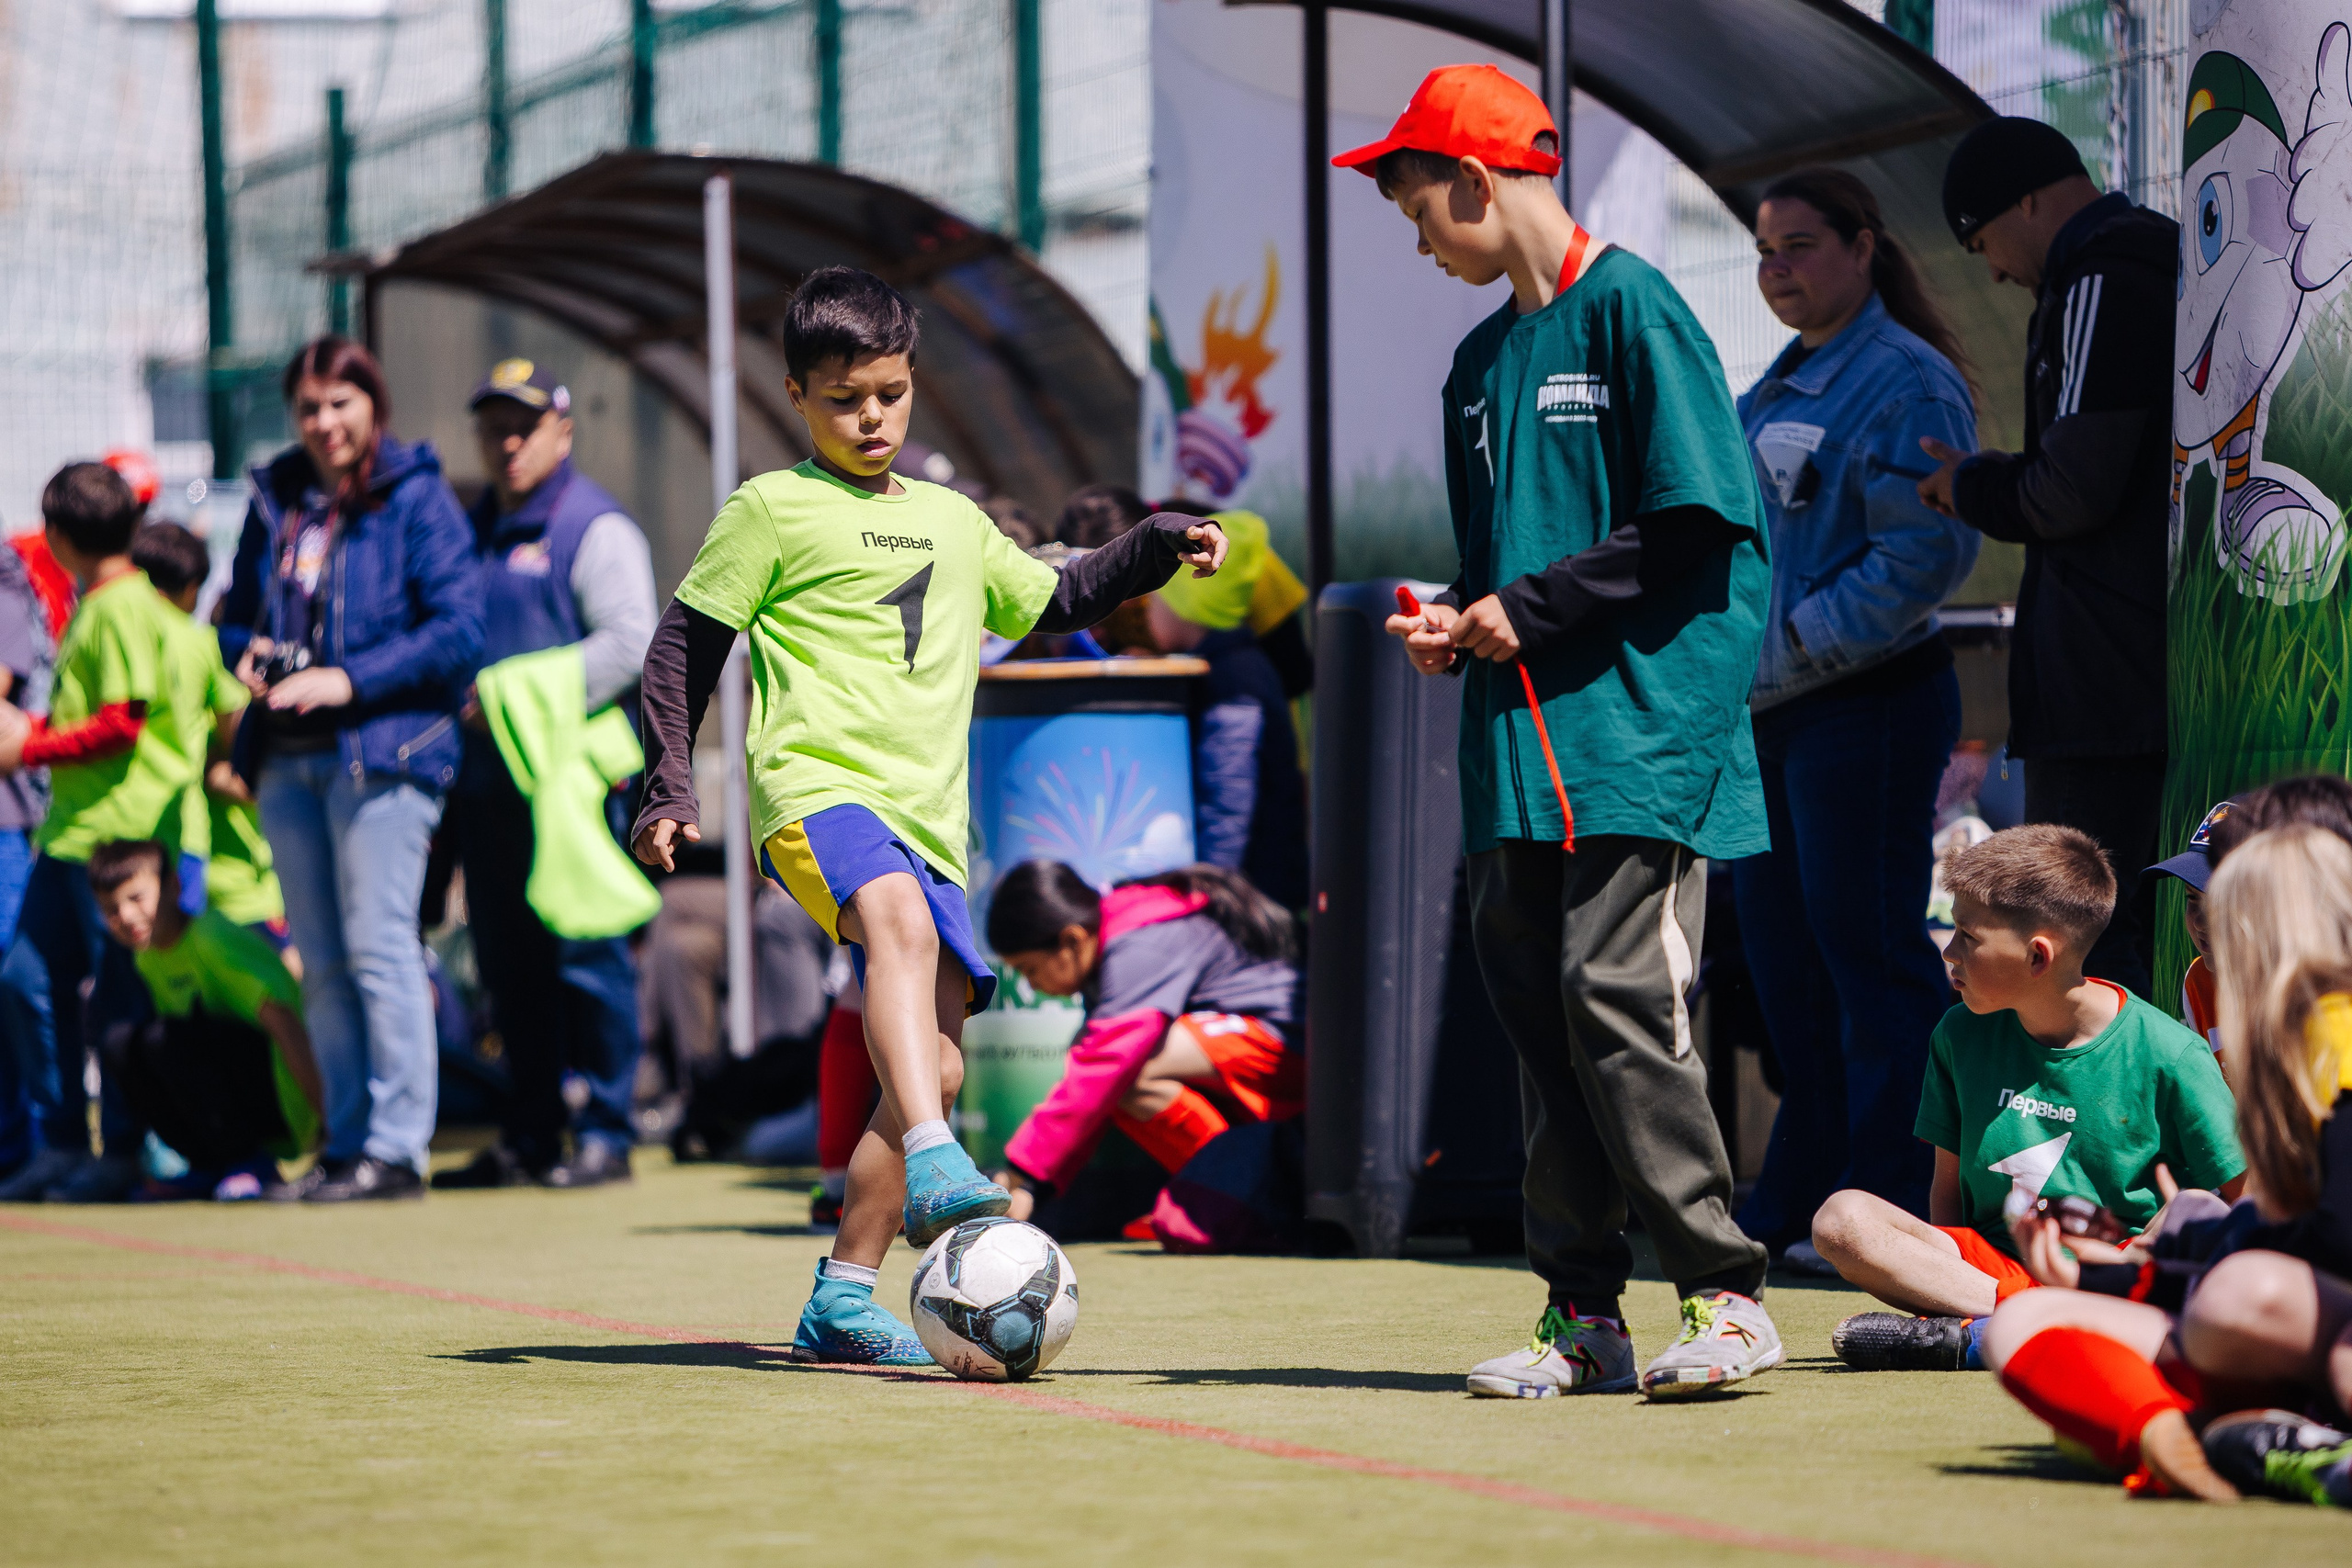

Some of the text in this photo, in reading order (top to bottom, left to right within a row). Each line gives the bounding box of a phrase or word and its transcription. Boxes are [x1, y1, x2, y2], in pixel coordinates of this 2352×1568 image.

[1537, 383, 1610, 412] КОМАНДА
[861, 532, 933, 553] Первые
[1997, 1088, 2076, 1123] Первые
